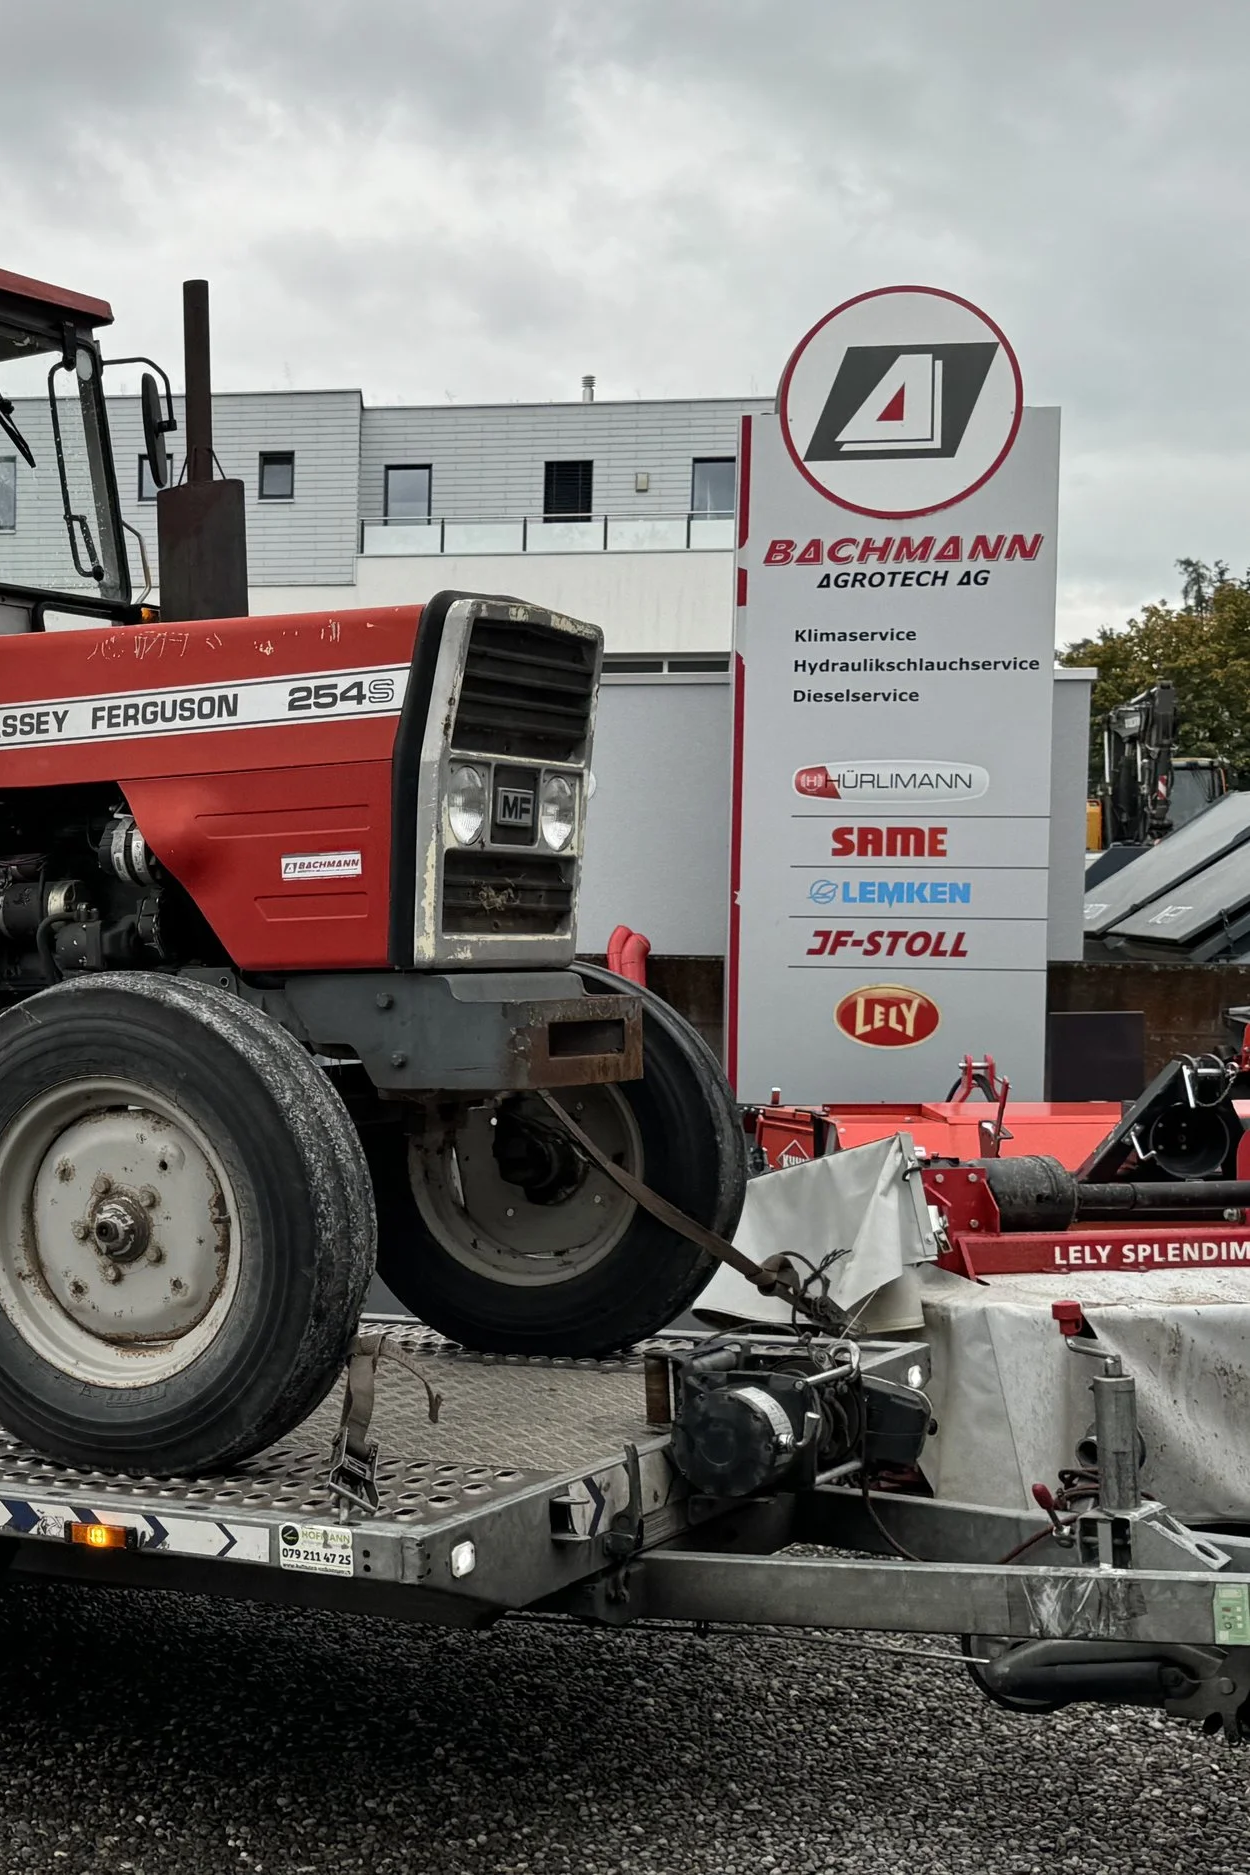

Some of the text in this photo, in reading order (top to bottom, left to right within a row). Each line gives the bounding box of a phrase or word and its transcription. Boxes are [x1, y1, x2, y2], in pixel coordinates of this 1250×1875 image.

[763, 534, 1044, 566] BACHMANN
[816, 569, 991, 589] AGROTECH AG
[794, 628, 917, 643] Klimaservice
[793, 657, 1040, 675] Hydraulikschlauchservice
[90, 693, 239, 730] FERGUSON
[287, 679, 395, 712] 254S
[792, 689, 920, 703] Dieselservice
[825, 769, 972, 789] HÜRLIMANN
[501, 794, 531, 822] MF
[831, 826, 948, 857] SAME
[297, 858, 360, 870] BACHMANN
[842, 881, 971, 908] LEMKEN
[806, 930, 968, 958] JF-STOLL
[854, 996, 920, 1038] LELY
[1054, 1240, 1250, 1265] LELY SPLENDIM
[282, 1547, 351, 1566] 079 211 47 25
